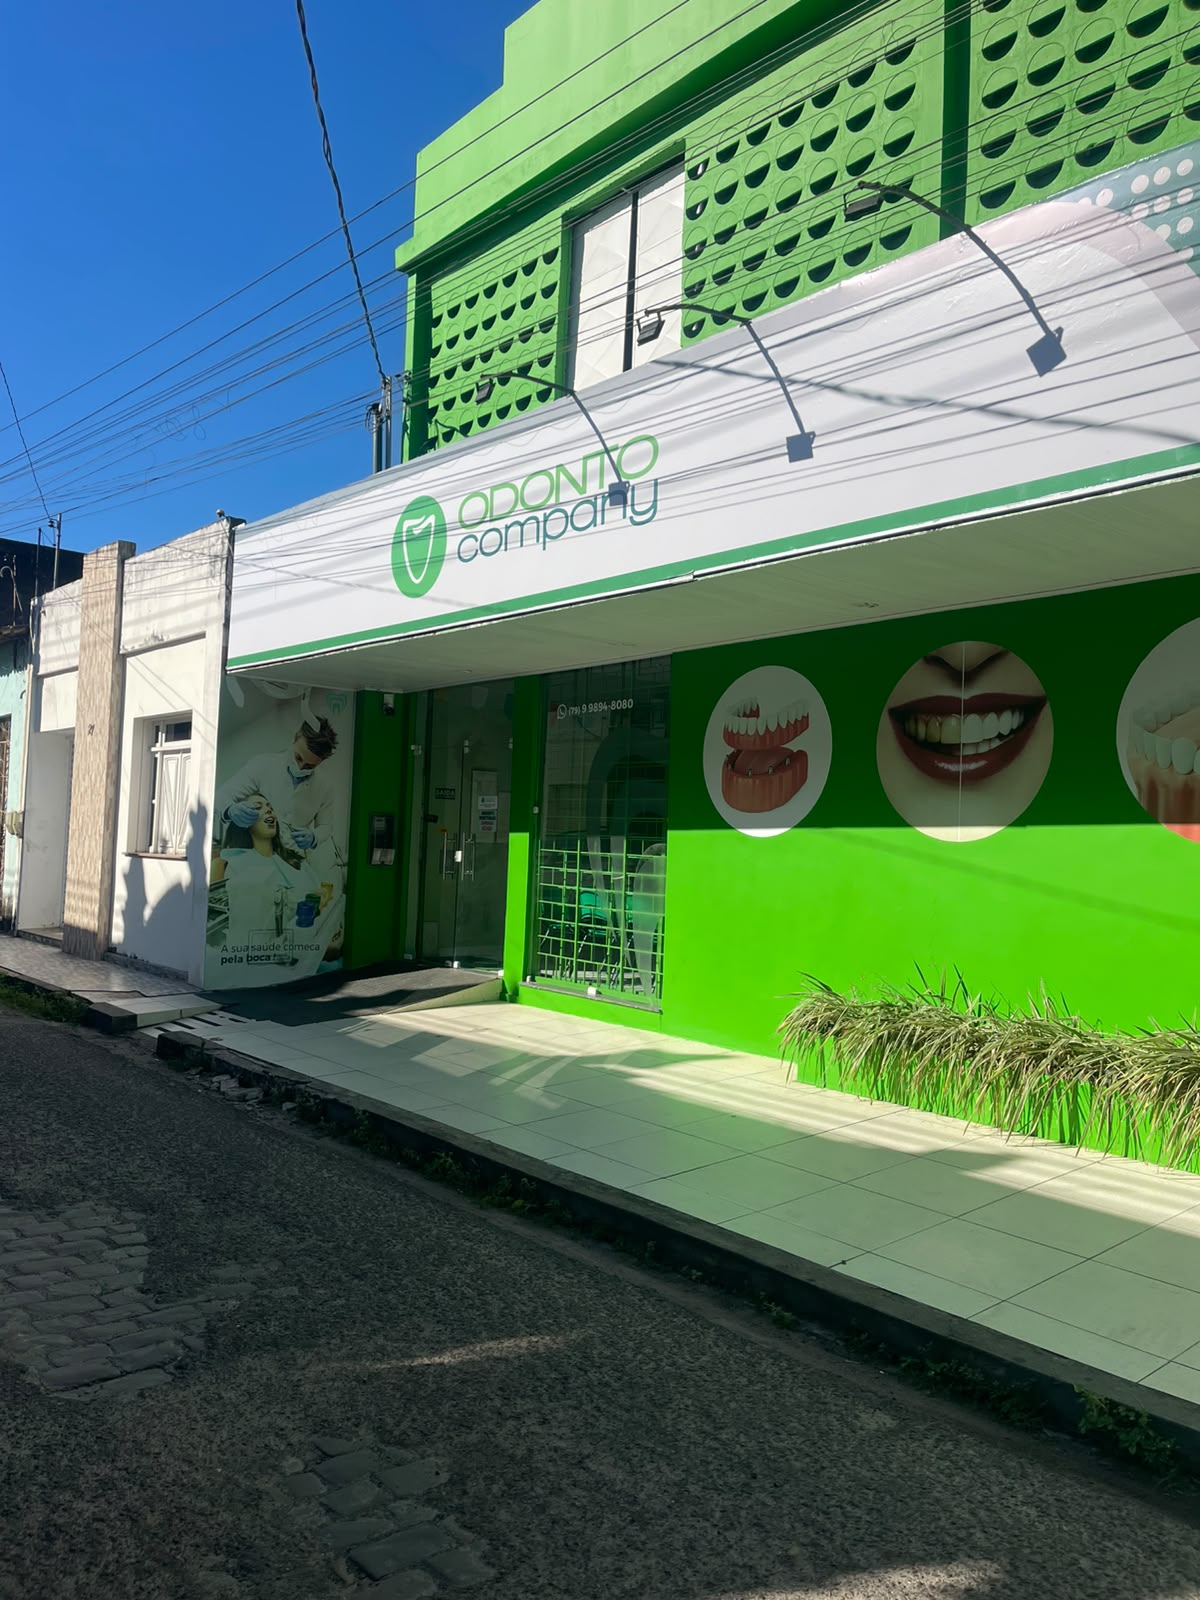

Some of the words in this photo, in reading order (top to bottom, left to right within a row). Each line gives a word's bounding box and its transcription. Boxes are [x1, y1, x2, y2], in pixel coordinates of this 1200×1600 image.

[458, 434, 659, 530] ODONTO
[457, 478, 658, 562] company
[568, 706, 581, 716] (79)
[581, 704, 587, 713] 9
[588, 699, 633, 712] 9894-8080
[220, 944, 229, 953] A
[231, 945, 249, 953] sua
[251, 942, 281, 952] saúde
[220, 954, 244, 966] pela
